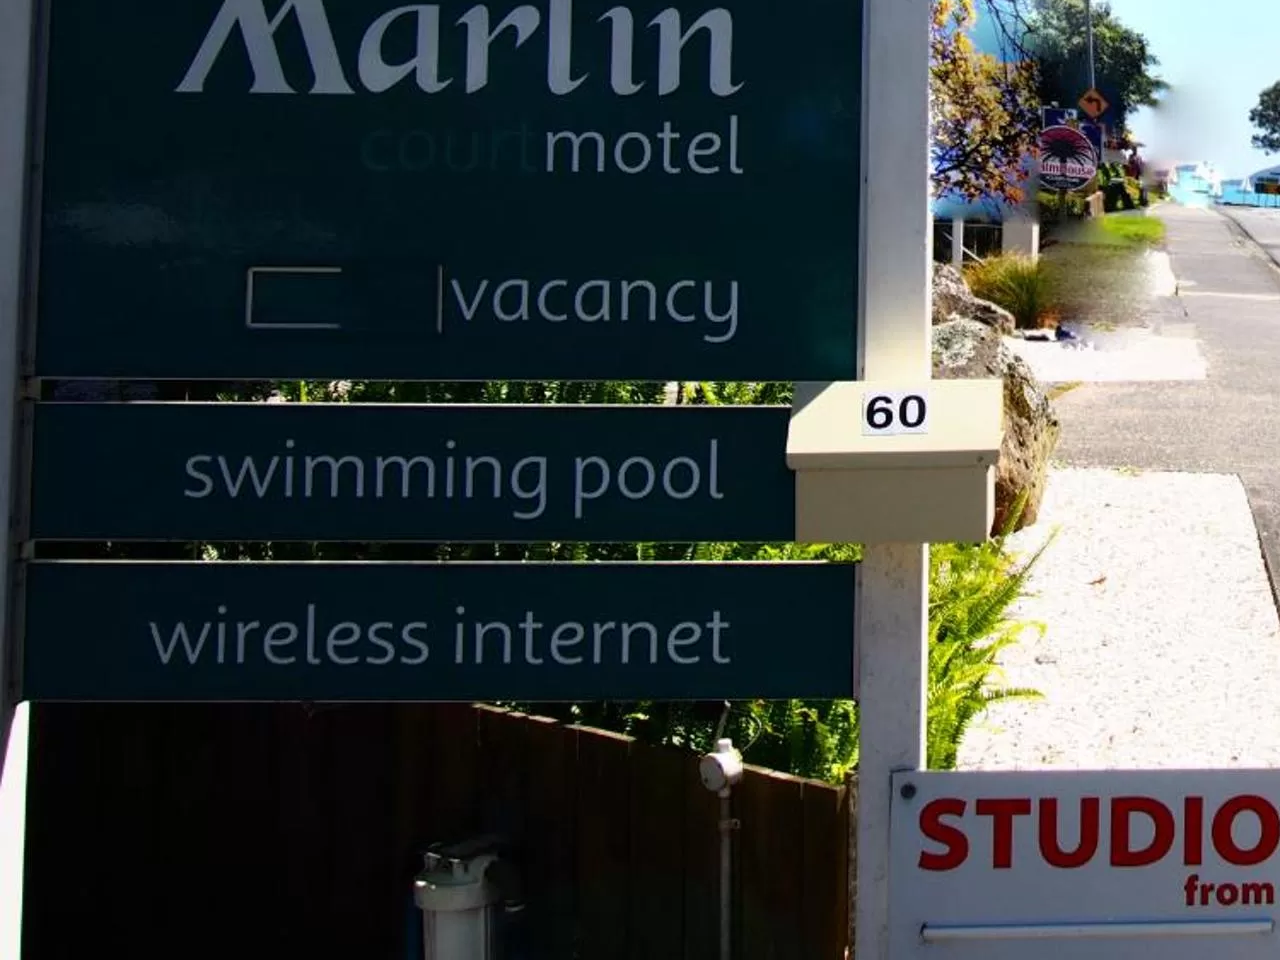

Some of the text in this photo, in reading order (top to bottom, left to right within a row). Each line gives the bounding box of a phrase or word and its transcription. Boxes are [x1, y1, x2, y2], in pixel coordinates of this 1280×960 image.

[546, 114, 744, 175] motel
[450, 278, 740, 344] vacancy
[865, 394, 927, 430] 60
[183, 438, 725, 520] swimming pool
[150, 604, 731, 665] wireless internet
[1184, 874, 1275, 906] from
